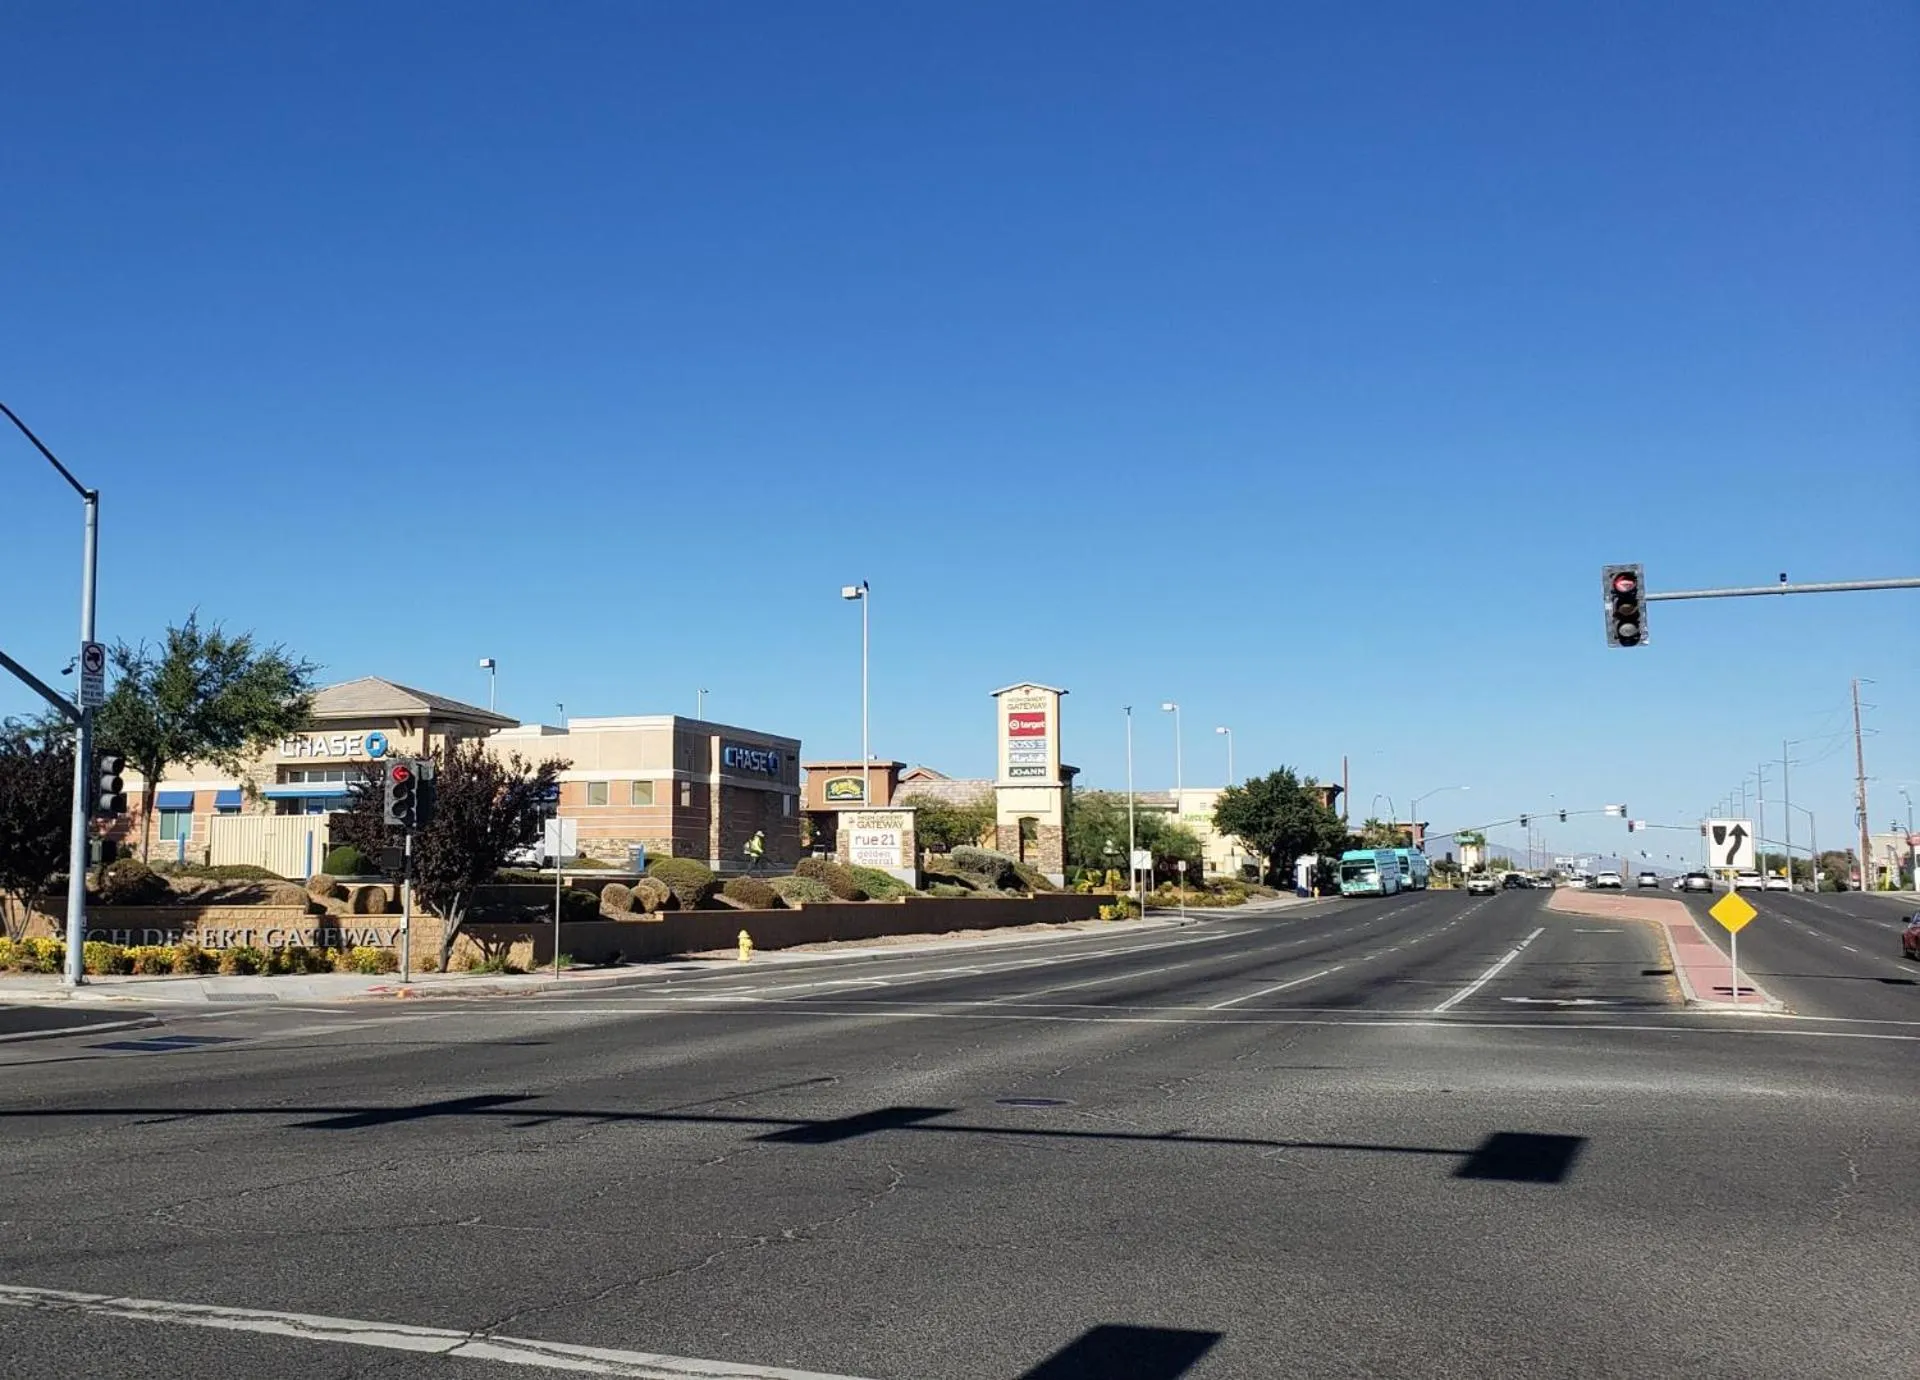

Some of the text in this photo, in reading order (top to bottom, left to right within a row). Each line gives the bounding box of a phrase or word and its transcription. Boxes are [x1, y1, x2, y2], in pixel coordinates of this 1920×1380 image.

[1020, 720, 1046, 729] target
[280, 734, 363, 757] CHASE
[725, 747, 767, 771] CHASE
[856, 820, 904, 829] GATEWAY
[142, 928, 257, 949] DESERT
[263, 927, 400, 949] GATEWAY
